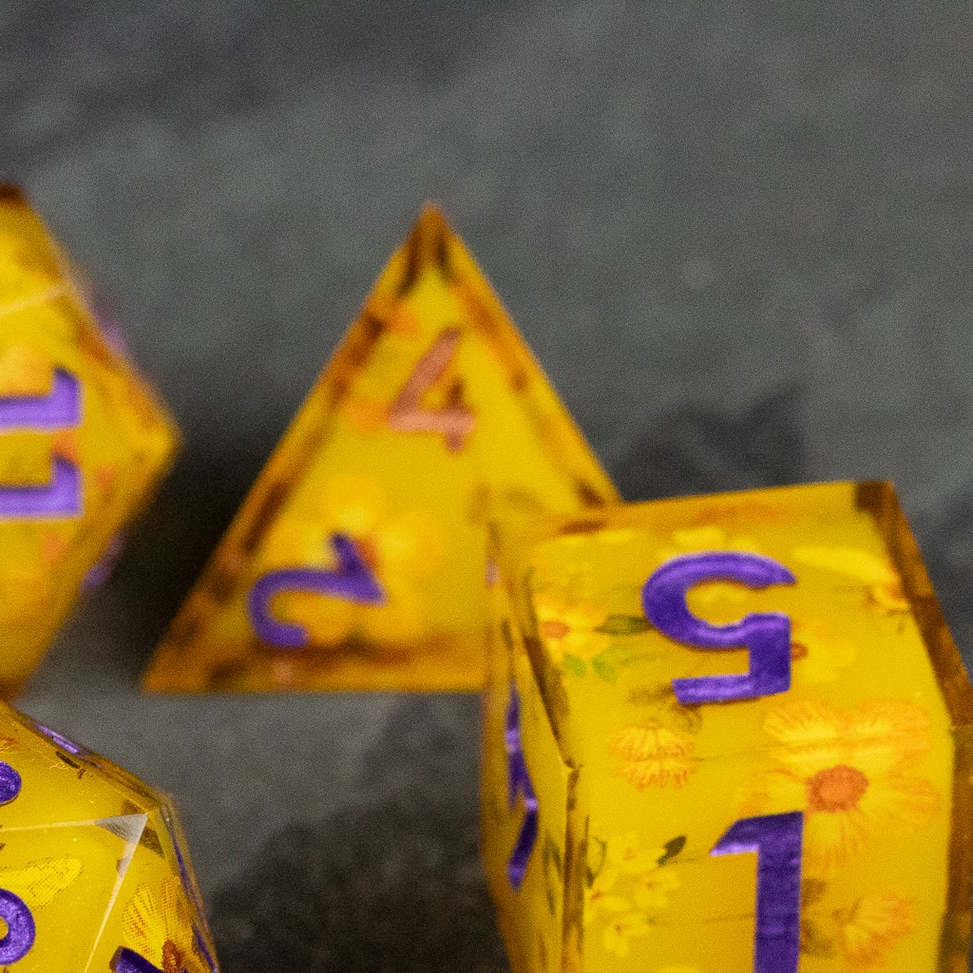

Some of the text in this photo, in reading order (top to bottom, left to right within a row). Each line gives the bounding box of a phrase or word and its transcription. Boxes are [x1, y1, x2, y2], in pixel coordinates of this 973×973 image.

[388, 326, 477, 455] 4
[246, 528, 389, 648] 2
[640, 550, 797, 706] 5
